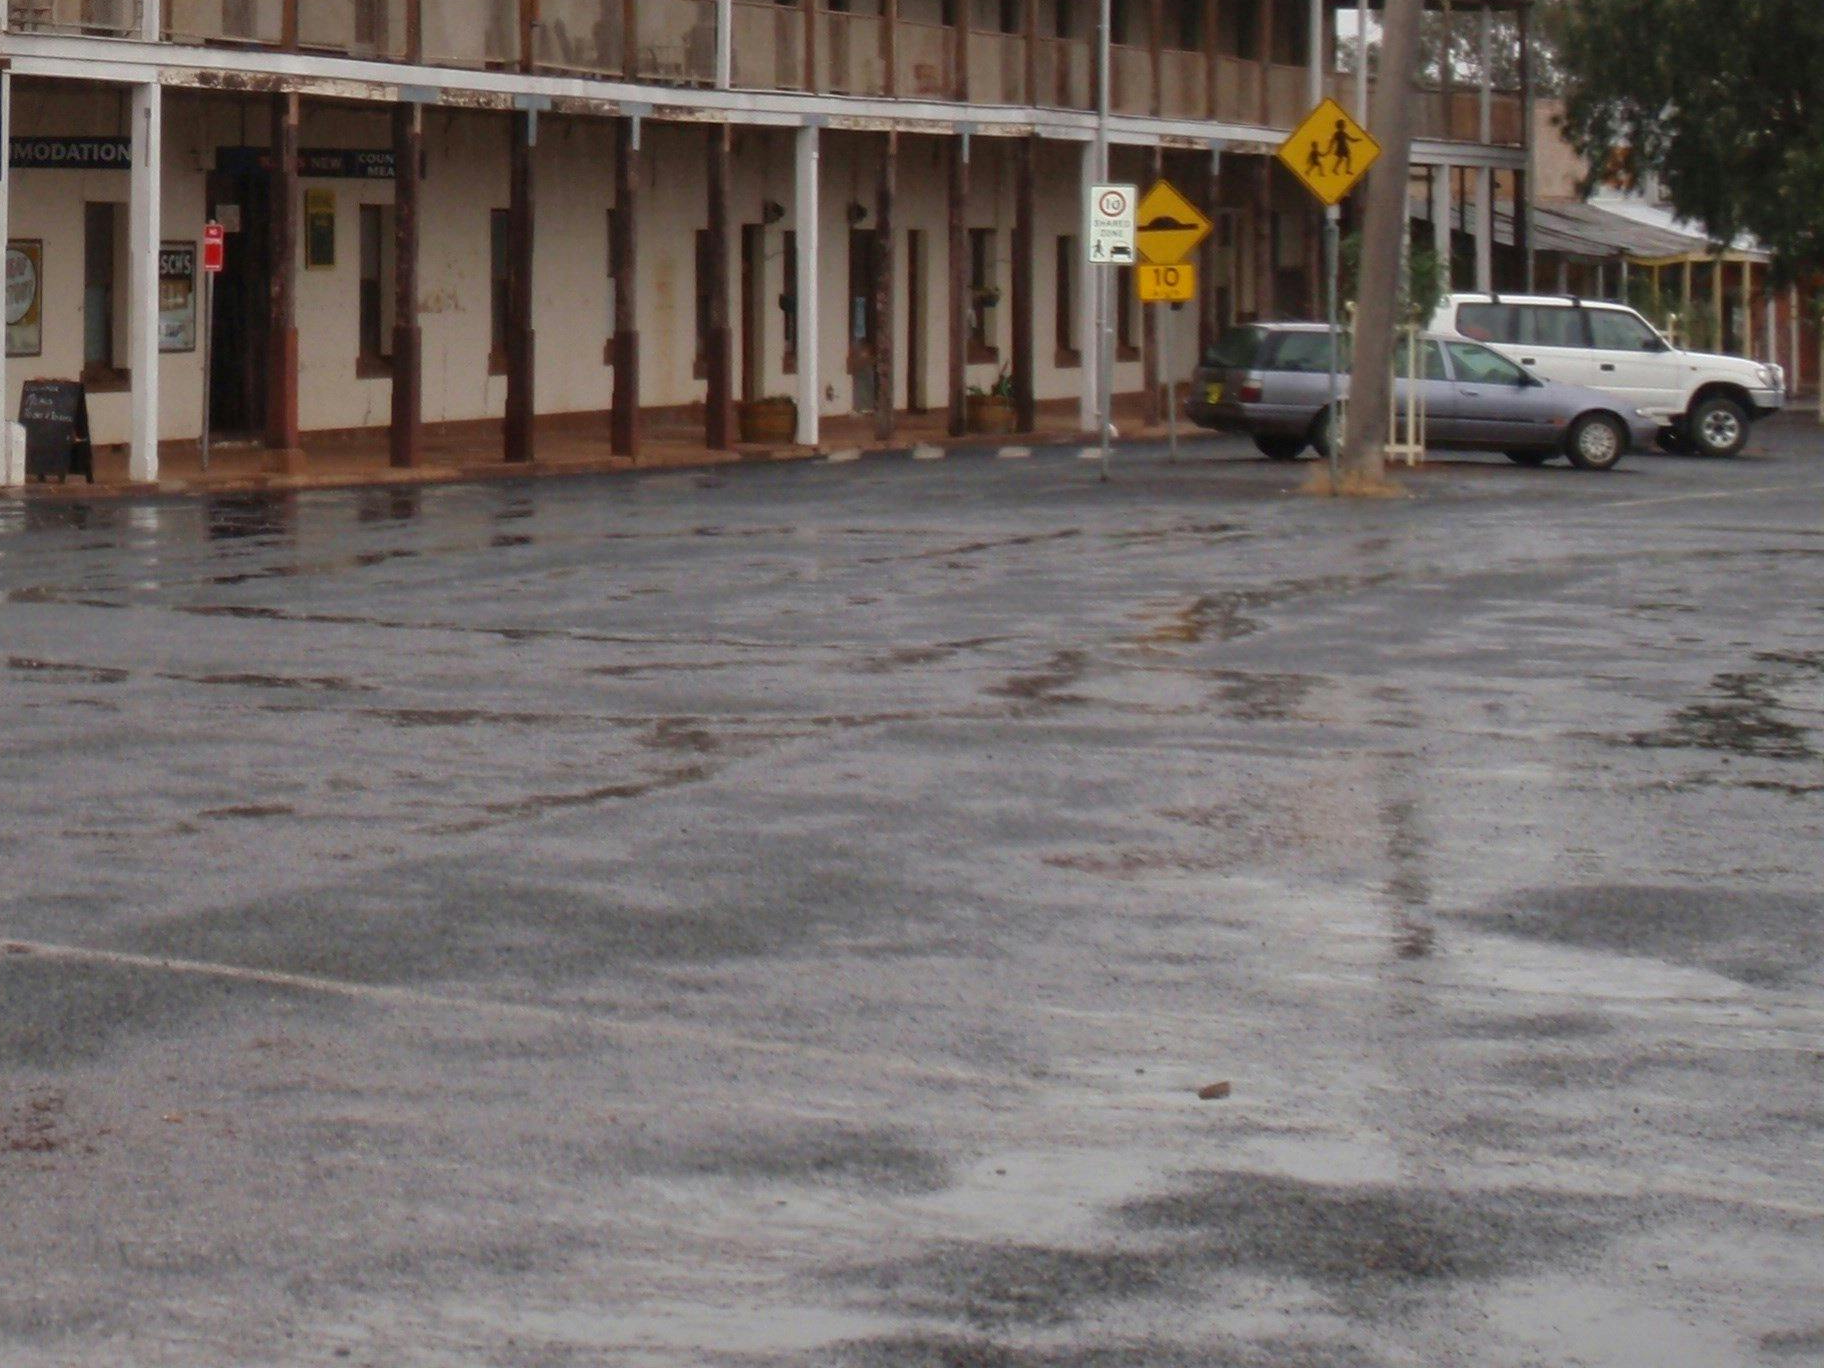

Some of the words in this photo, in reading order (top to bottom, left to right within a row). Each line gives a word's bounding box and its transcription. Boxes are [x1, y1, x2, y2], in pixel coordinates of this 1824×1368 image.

[10, 143, 132, 161] MODATION
[359, 153, 394, 164] COUN
[367, 166, 395, 177] MEA
[1105, 198, 1121, 210] 10
[1094, 219, 1131, 228] SHARED
[1100, 229, 1123, 238] ZONE
[1153, 267, 1179, 286] 10
